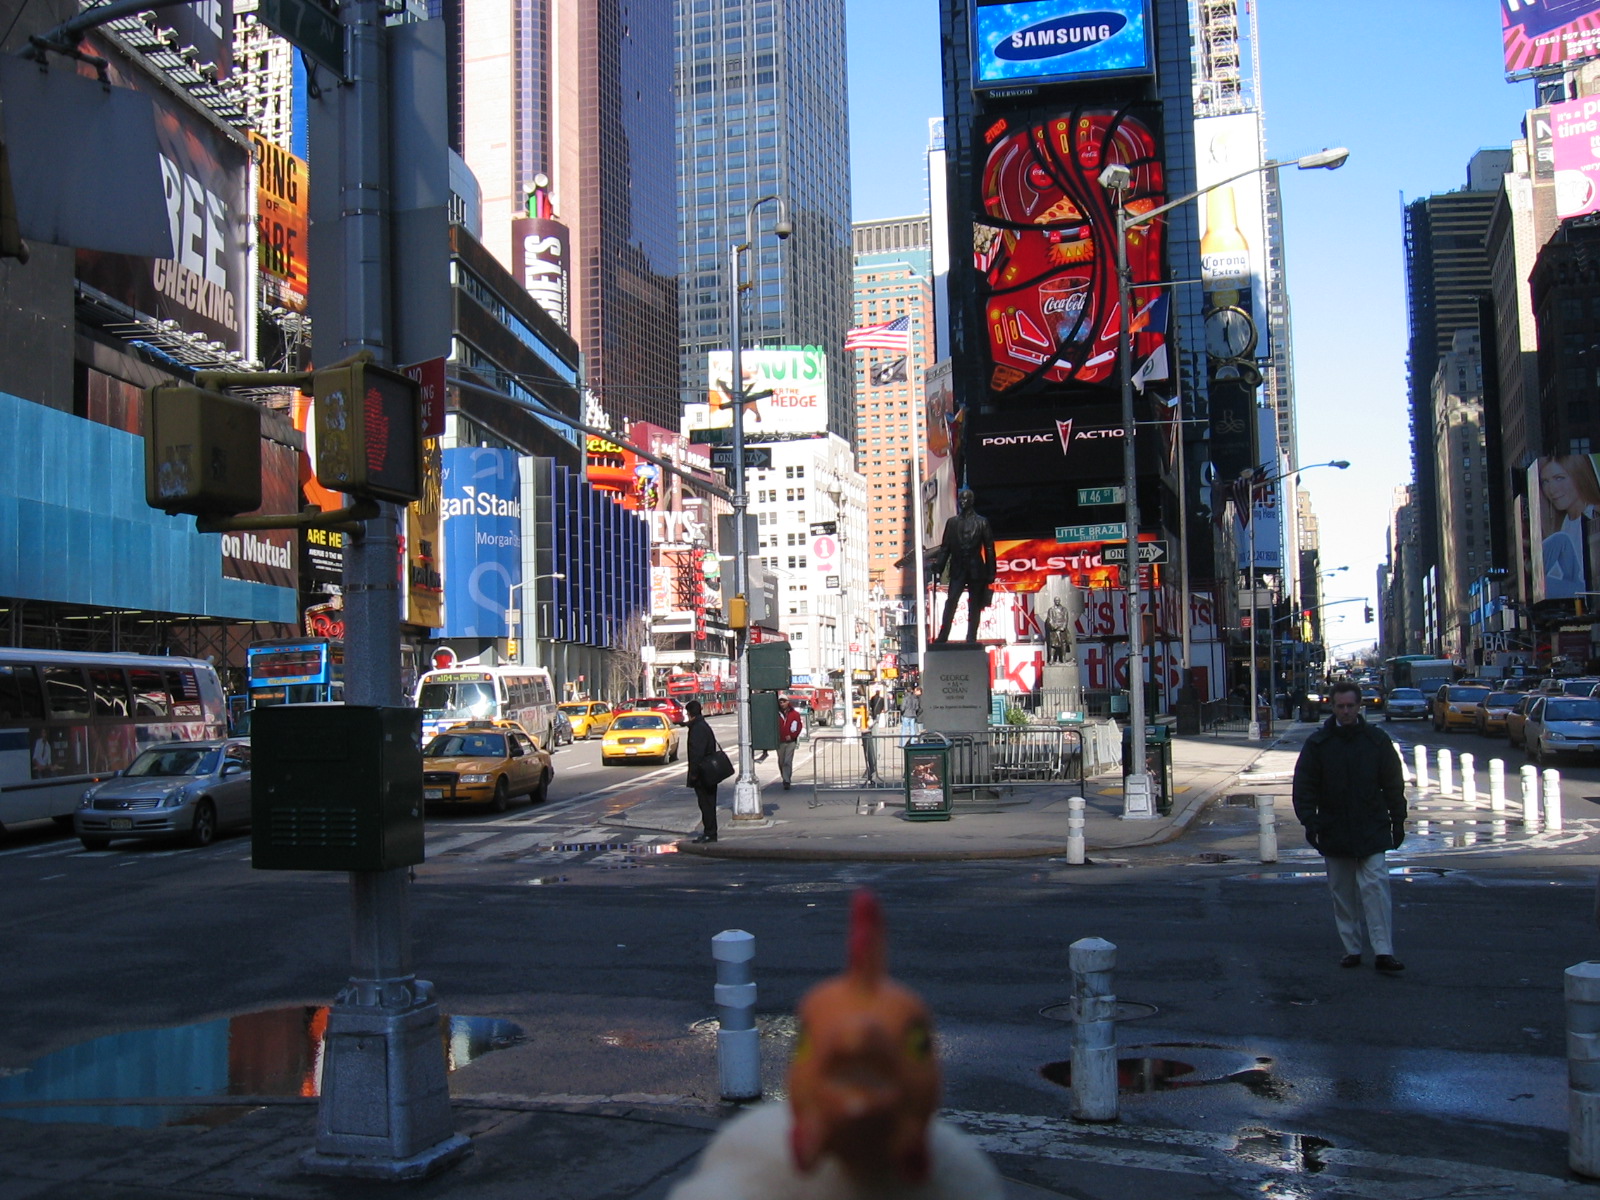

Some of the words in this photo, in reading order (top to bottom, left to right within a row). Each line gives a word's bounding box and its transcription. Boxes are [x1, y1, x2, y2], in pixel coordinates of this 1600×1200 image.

[1011, 24, 1110, 48] SAMSUNG
[989, 89, 1033, 98] SHERWOOD
[1558, 119, 1597, 138] time
[254, 137, 297, 206] RING
[266, 199, 279, 211] OF
[159, 152, 226, 290] REE
[257, 215, 297, 281] FIRE
[1202, 256, 1246, 271] Corona
[1212, 269, 1240, 277] Extra
[153, 257, 239, 332] CHECKING.
[1044, 292, 1088, 315] Coca-Col
[408, 367, 423, 384] NO
[771, 395, 818, 408] HEDGE
[982, 433, 1054, 446] PONTIAC
[1074, 428, 1136, 440] ACTIO
[1079, 491, 1087, 503] W
[1090, 490, 1101, 502] 46
[441, 498, 475, 521] gan
[308, 528, 327, 546] ARE
[328, 531, 342, 548] HE
[1056, 528, 1085, 537] LITTLE
[1089, 525, 1122, 534] BRAZIL
[243, 533, 291, 569] Mutual
[1137, 548, 1157, 558] WAY
[996, 554, 1102, 573] SOLSTIC
[940, 674, 969, 682] GEORGE
